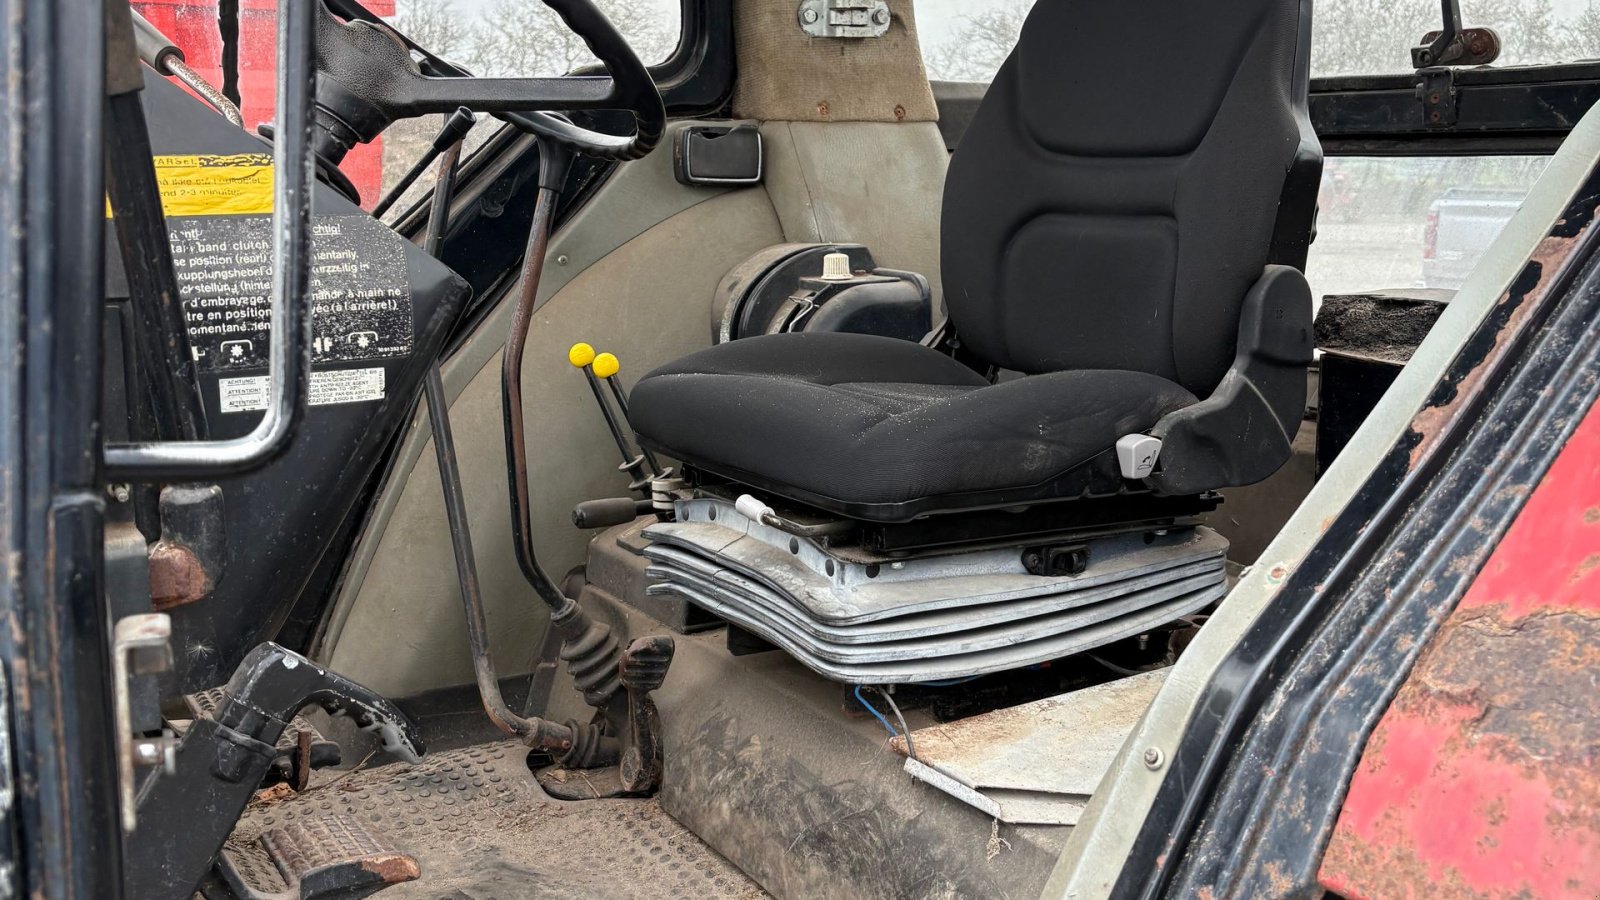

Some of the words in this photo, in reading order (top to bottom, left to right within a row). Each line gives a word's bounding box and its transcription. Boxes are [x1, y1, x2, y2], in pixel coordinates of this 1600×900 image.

[180, 188, 196, 196] 2-3
[232, 240, 269, 251] clutch
[189, 254, 233, 267] position
[180, 282, 239, 295] ckstellung
[207, 311, 222, 321] en
[225, 306, 273, 321] position
